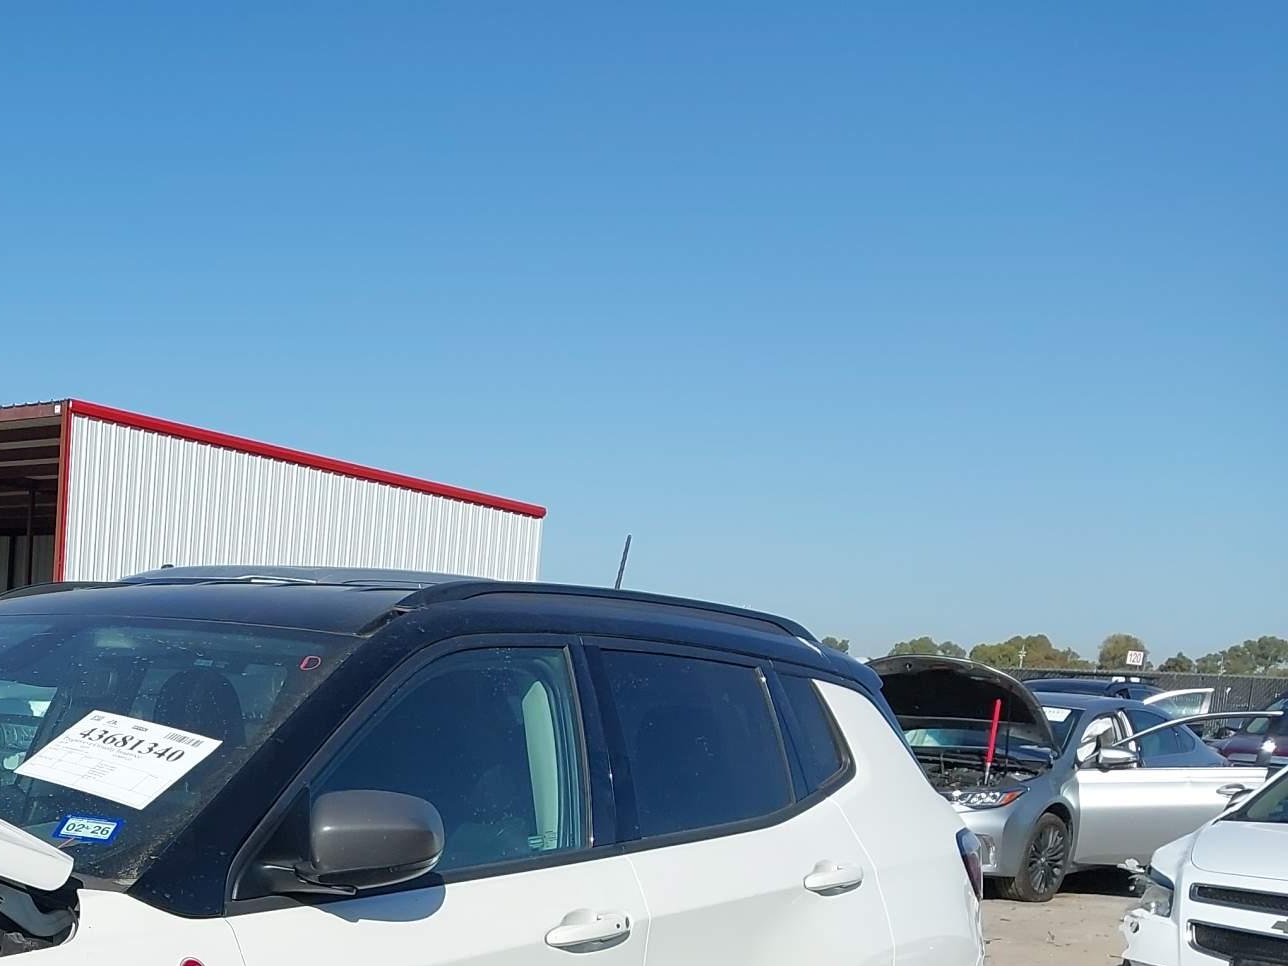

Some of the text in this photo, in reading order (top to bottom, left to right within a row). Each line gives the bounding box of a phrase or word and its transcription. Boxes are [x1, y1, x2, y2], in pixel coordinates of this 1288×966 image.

[79, 726, 185, 763] 43681340
[65, 822, 111, 836] 02 26
